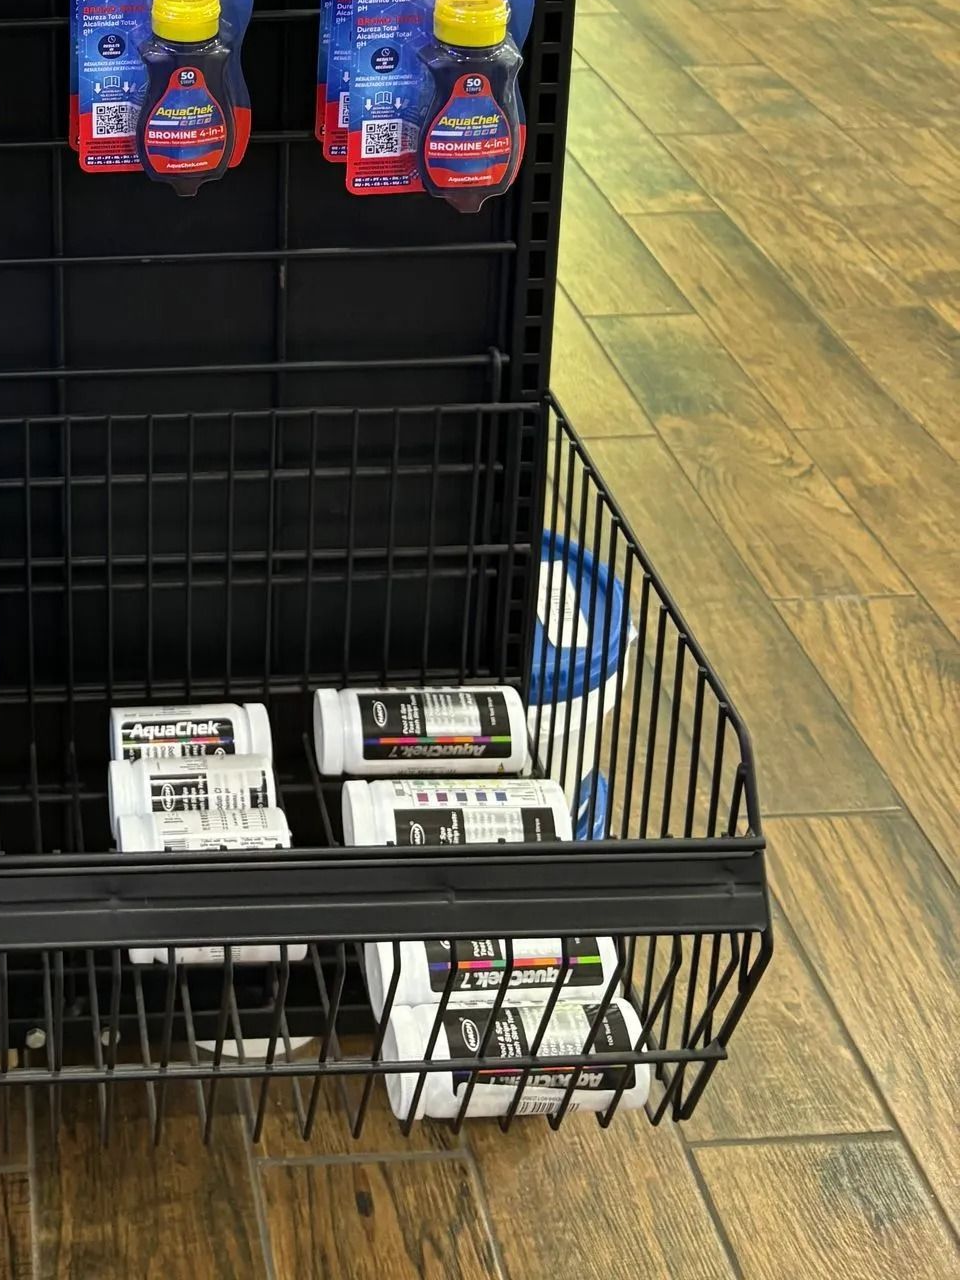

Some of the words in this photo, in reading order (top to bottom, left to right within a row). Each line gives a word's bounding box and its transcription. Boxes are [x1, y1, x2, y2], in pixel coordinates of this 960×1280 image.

[180, 71, 195, 80] 50
[466, 78, 481, 87] 50
[155, 104, 214, 119] AquaChek
[438, 114, 499, 128] AquaChek
[148, 130, 197, 139] BROMINE
[199, 126, 224, 137] 4-in-1
[429, 142, 482, 151] BROMINE
[484, 137, 509, 149] 4-in-1
[129, 720, 219, 739] AquaChek
[460, 973, 471, 988] 7
[467, 1022, 477, 1047] HACH
[502, 1021, 512, 1042] Strips
[510, 1024, 519, 1040] Strip
